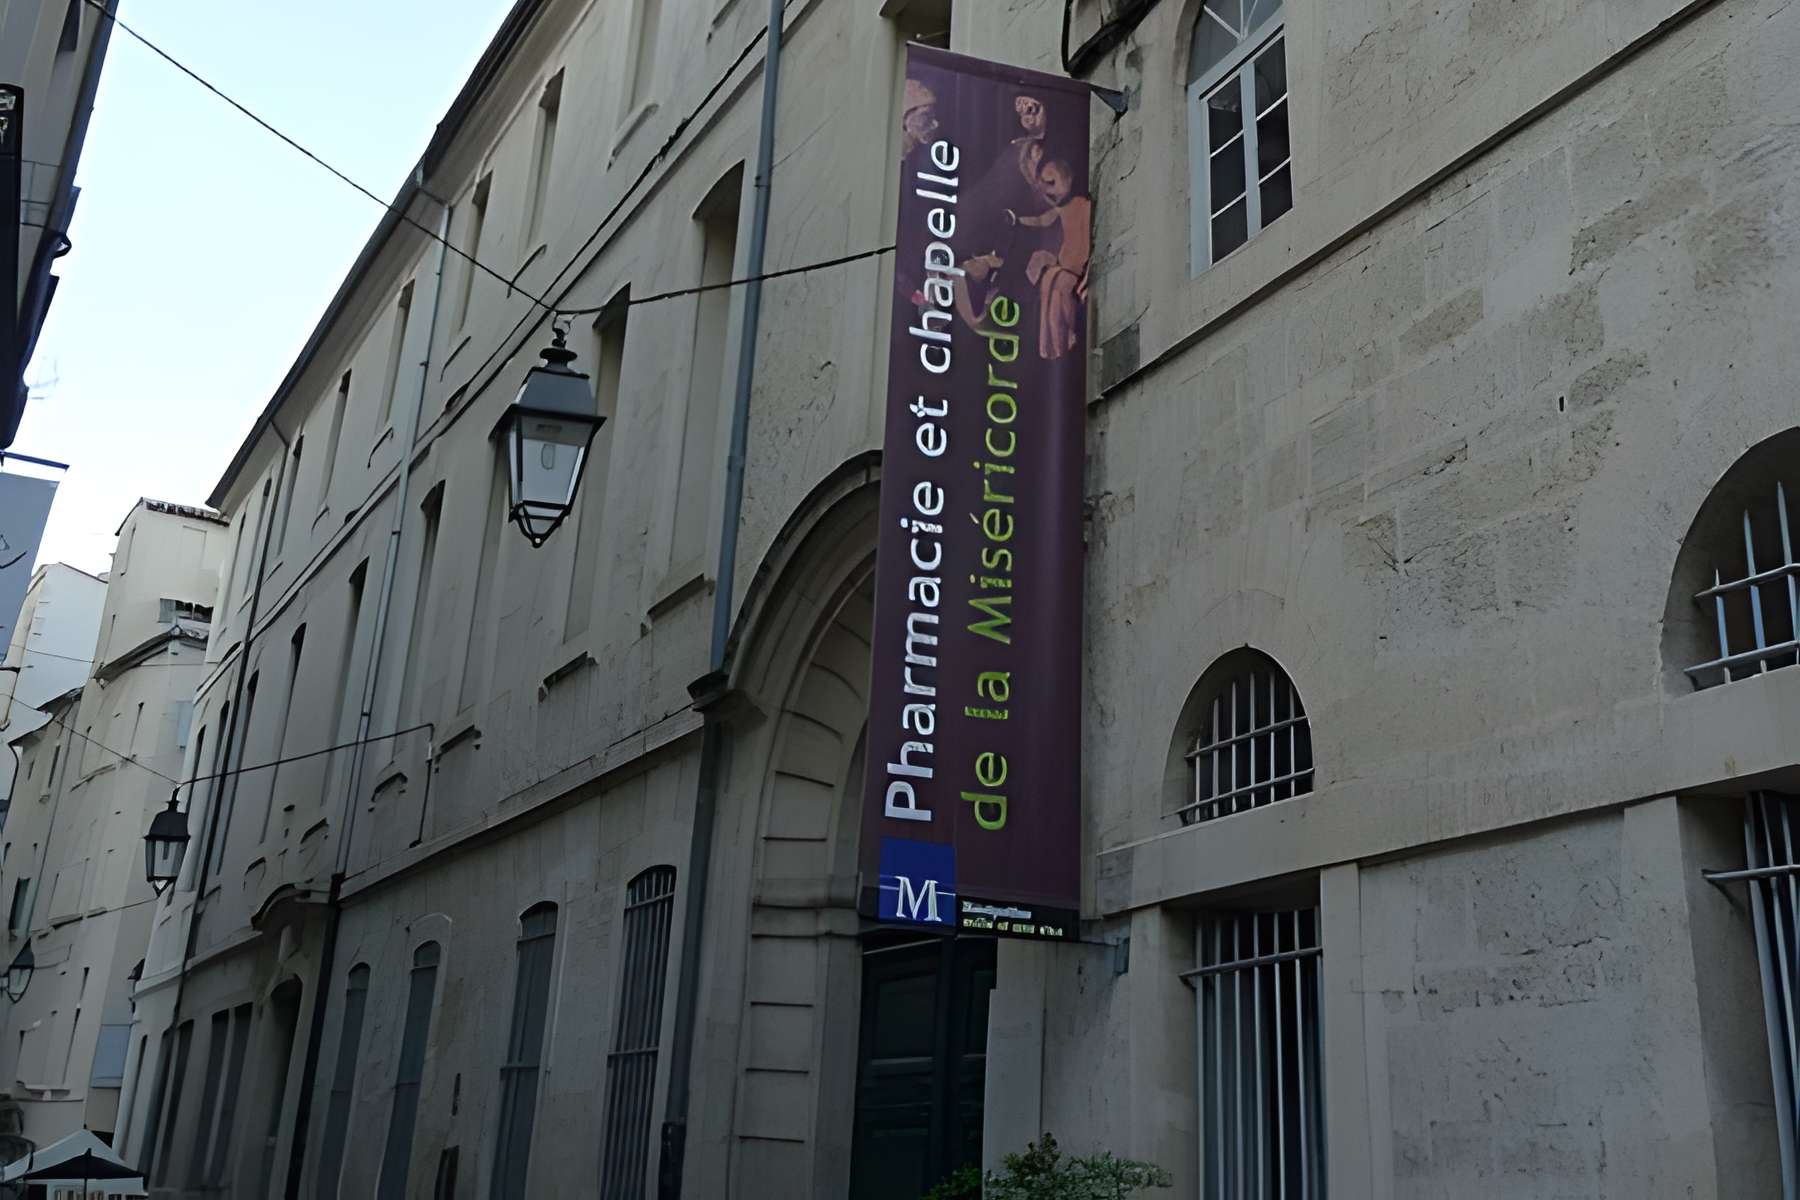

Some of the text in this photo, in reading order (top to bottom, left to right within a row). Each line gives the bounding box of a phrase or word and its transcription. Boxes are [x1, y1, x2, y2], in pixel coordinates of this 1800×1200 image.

[885, 139, 966, 822] Pharmacie et chapelle
[960, 294, 1021, 831] de la Miséricorde
[895, 875, 943, 922] M
